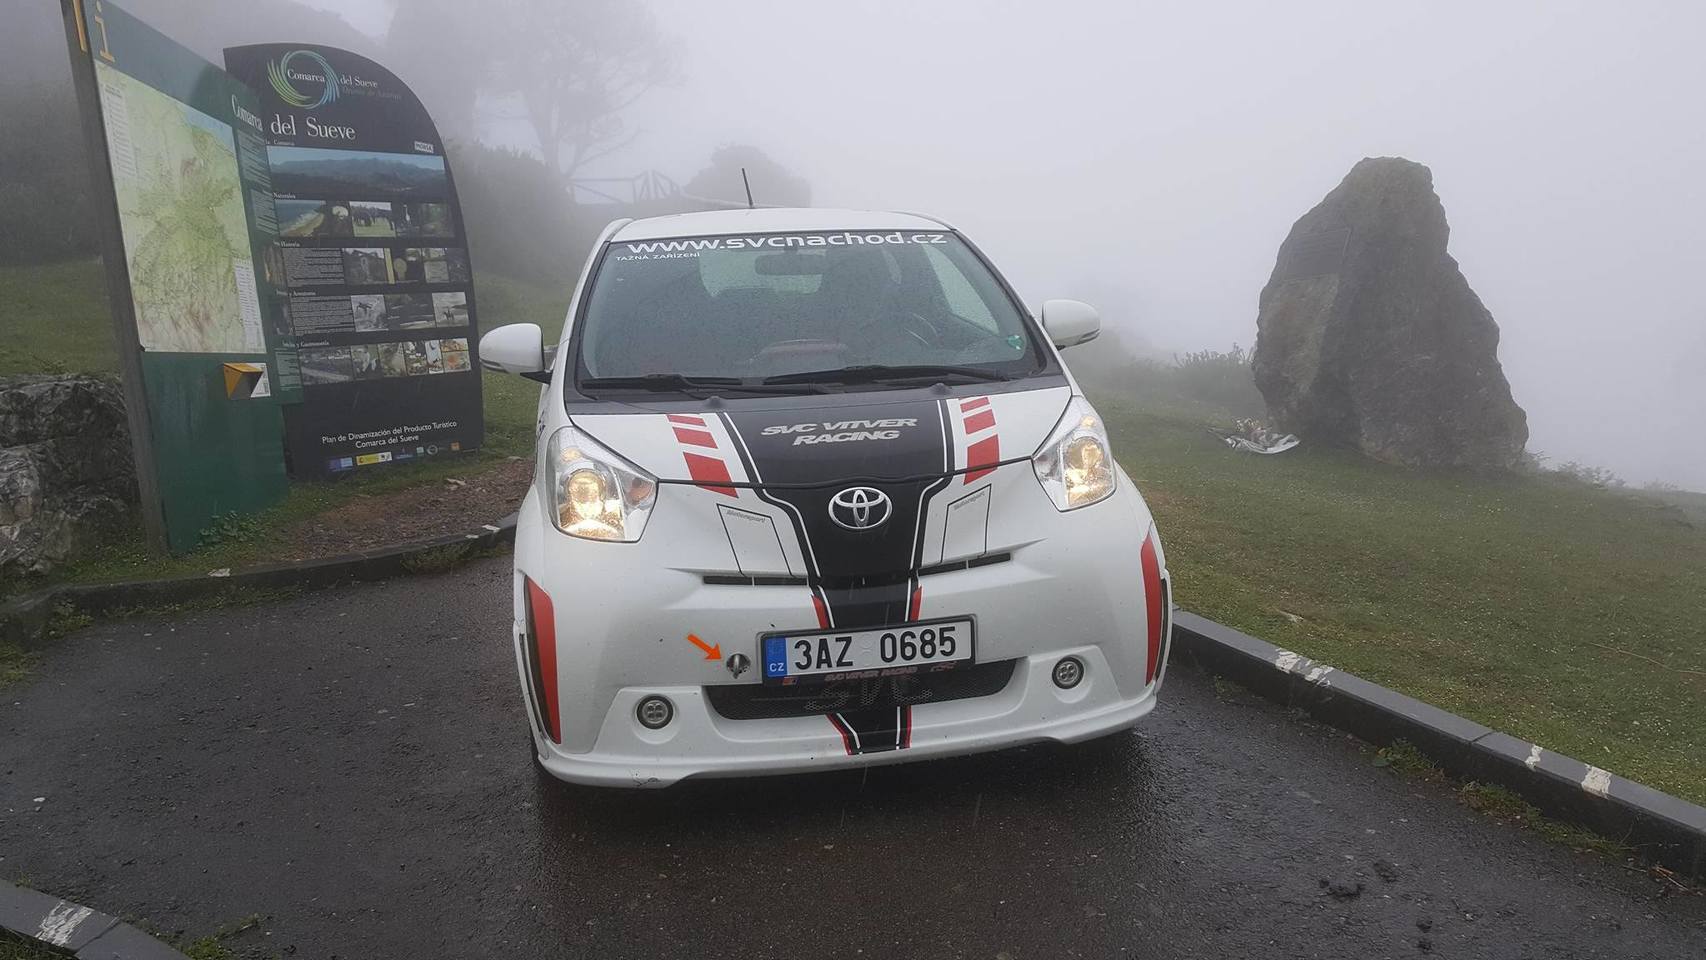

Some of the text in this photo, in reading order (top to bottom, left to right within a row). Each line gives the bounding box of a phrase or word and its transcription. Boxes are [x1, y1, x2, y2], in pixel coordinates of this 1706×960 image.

[287, 68, 378, 89] Comarca del Sueve
[231, 94, 356, 140] Comarca del Sueve
[627, 232, 947, 254] www.svcnachod.cz
[322, 436, 337, 444] Plan
[348, 429, 391, 441] Dinamización
[392, 427, 402, 435] del
[403, 424, 432, 433] Producto
[432, 420, 457, 429] Turístico
[761, 418, 918, 436] SVC VITVER
[355, 439, 386, 449] Comarca
[399, 435, 419, 443] Sueve
[792, 430, 900, 446] RACING
[794, 626, 956, 670] 3AZ 0685
[769, 662, 785, 673] CZ
